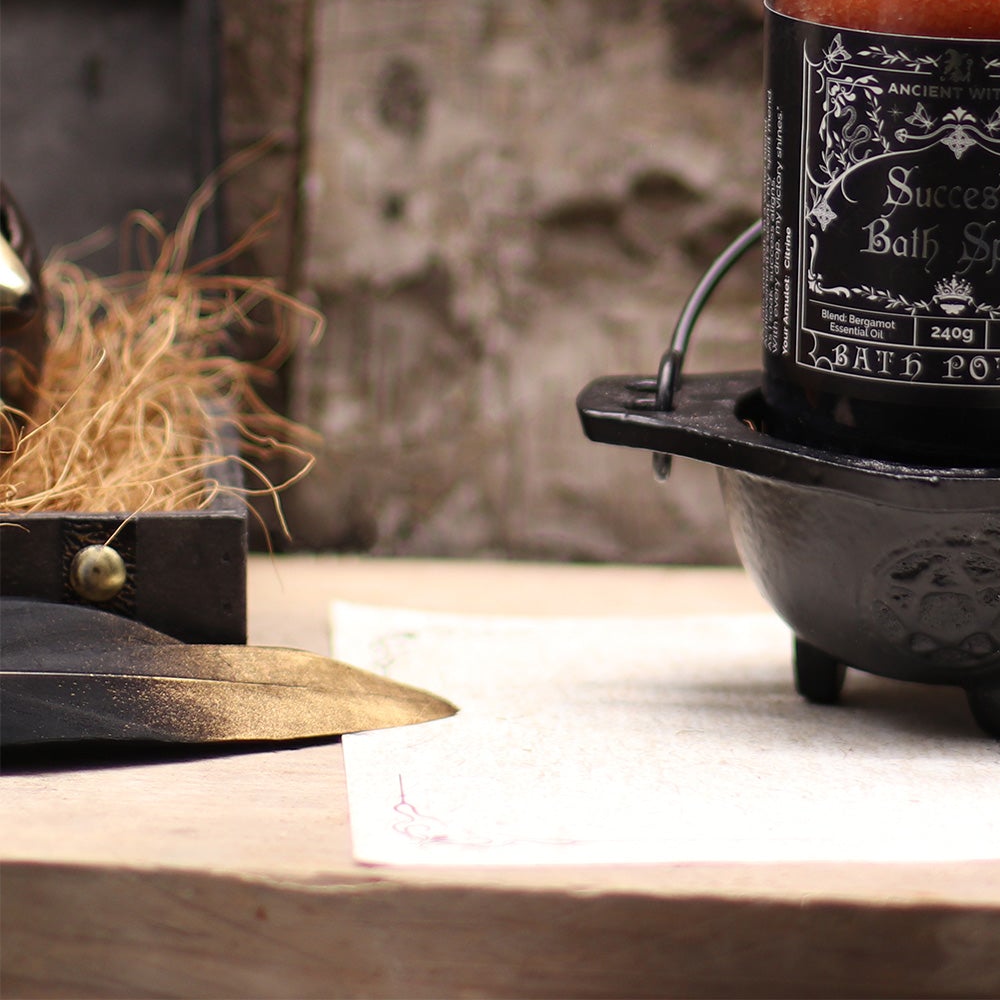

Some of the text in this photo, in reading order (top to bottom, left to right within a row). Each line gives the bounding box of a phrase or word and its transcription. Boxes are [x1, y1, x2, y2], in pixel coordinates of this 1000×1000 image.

[888, 82, 963, 99] ANCIENT
[860, 217, 940, 274] Bath
[821, 308, 896, 330] Blend: Bergamot
[829, 321, 884, 340] Essential Oil
[930, 326, 974, 343] 240g
